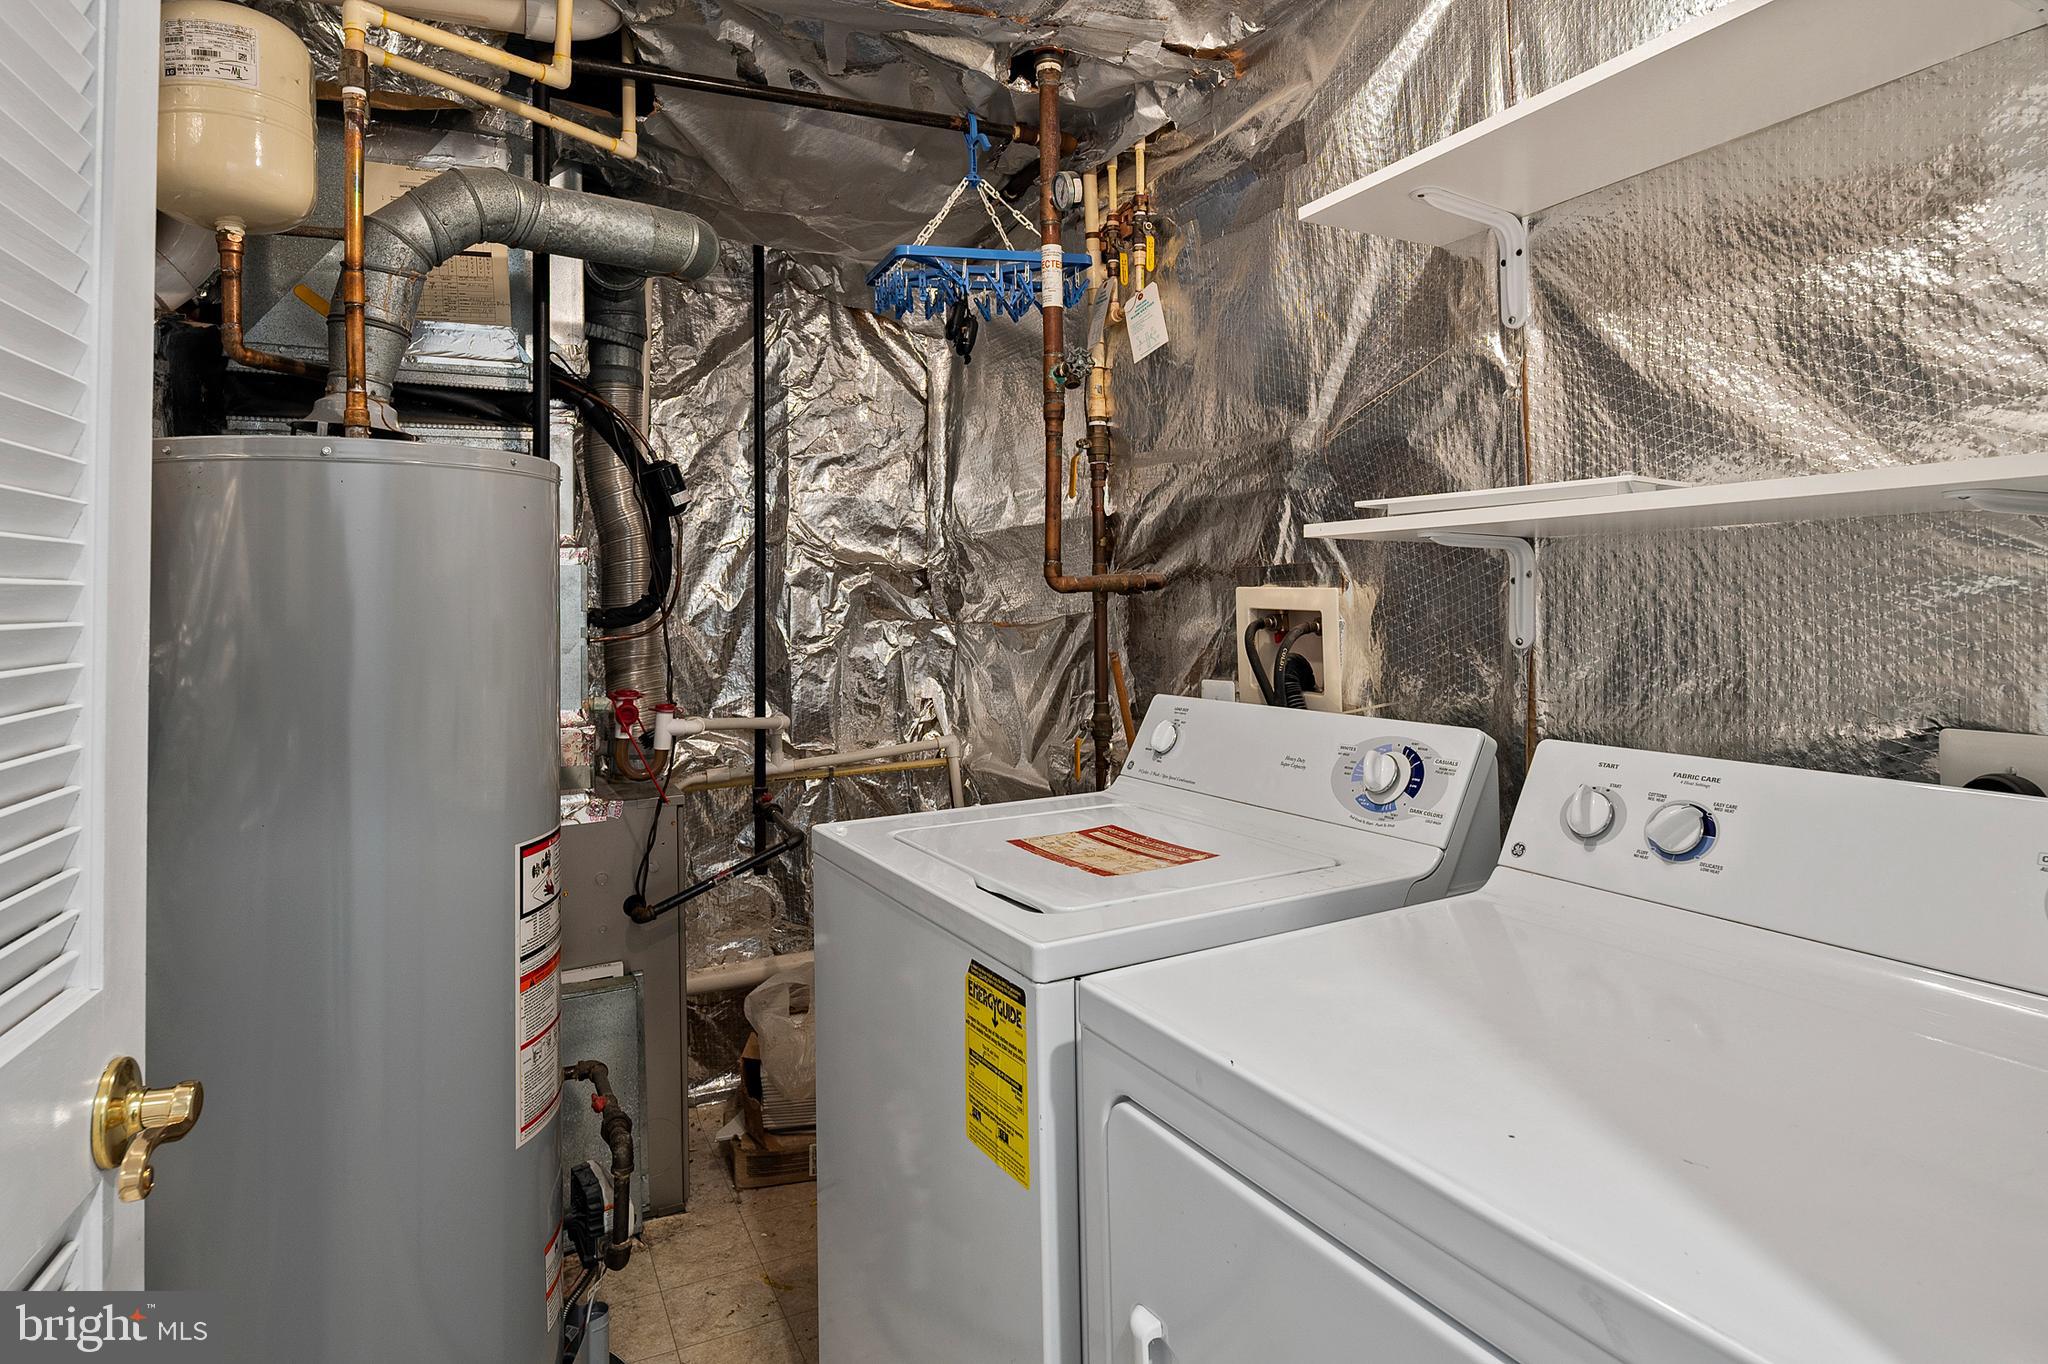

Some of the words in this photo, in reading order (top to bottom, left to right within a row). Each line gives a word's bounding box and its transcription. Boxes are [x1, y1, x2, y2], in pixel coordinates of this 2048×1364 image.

[1434, 758, 1459, 767] CASUALS
[1598, 762, 1620, 770] START
[1672, 772, 1700, 781] FABRIC
[1700, 776, 1722, 784] CARE
[1423, 811, 1443, 819] COLORS
[1699, 861, 1724, 871] DELICATES
[968, 979, 1023, 1029] ENERGYGUIDE
